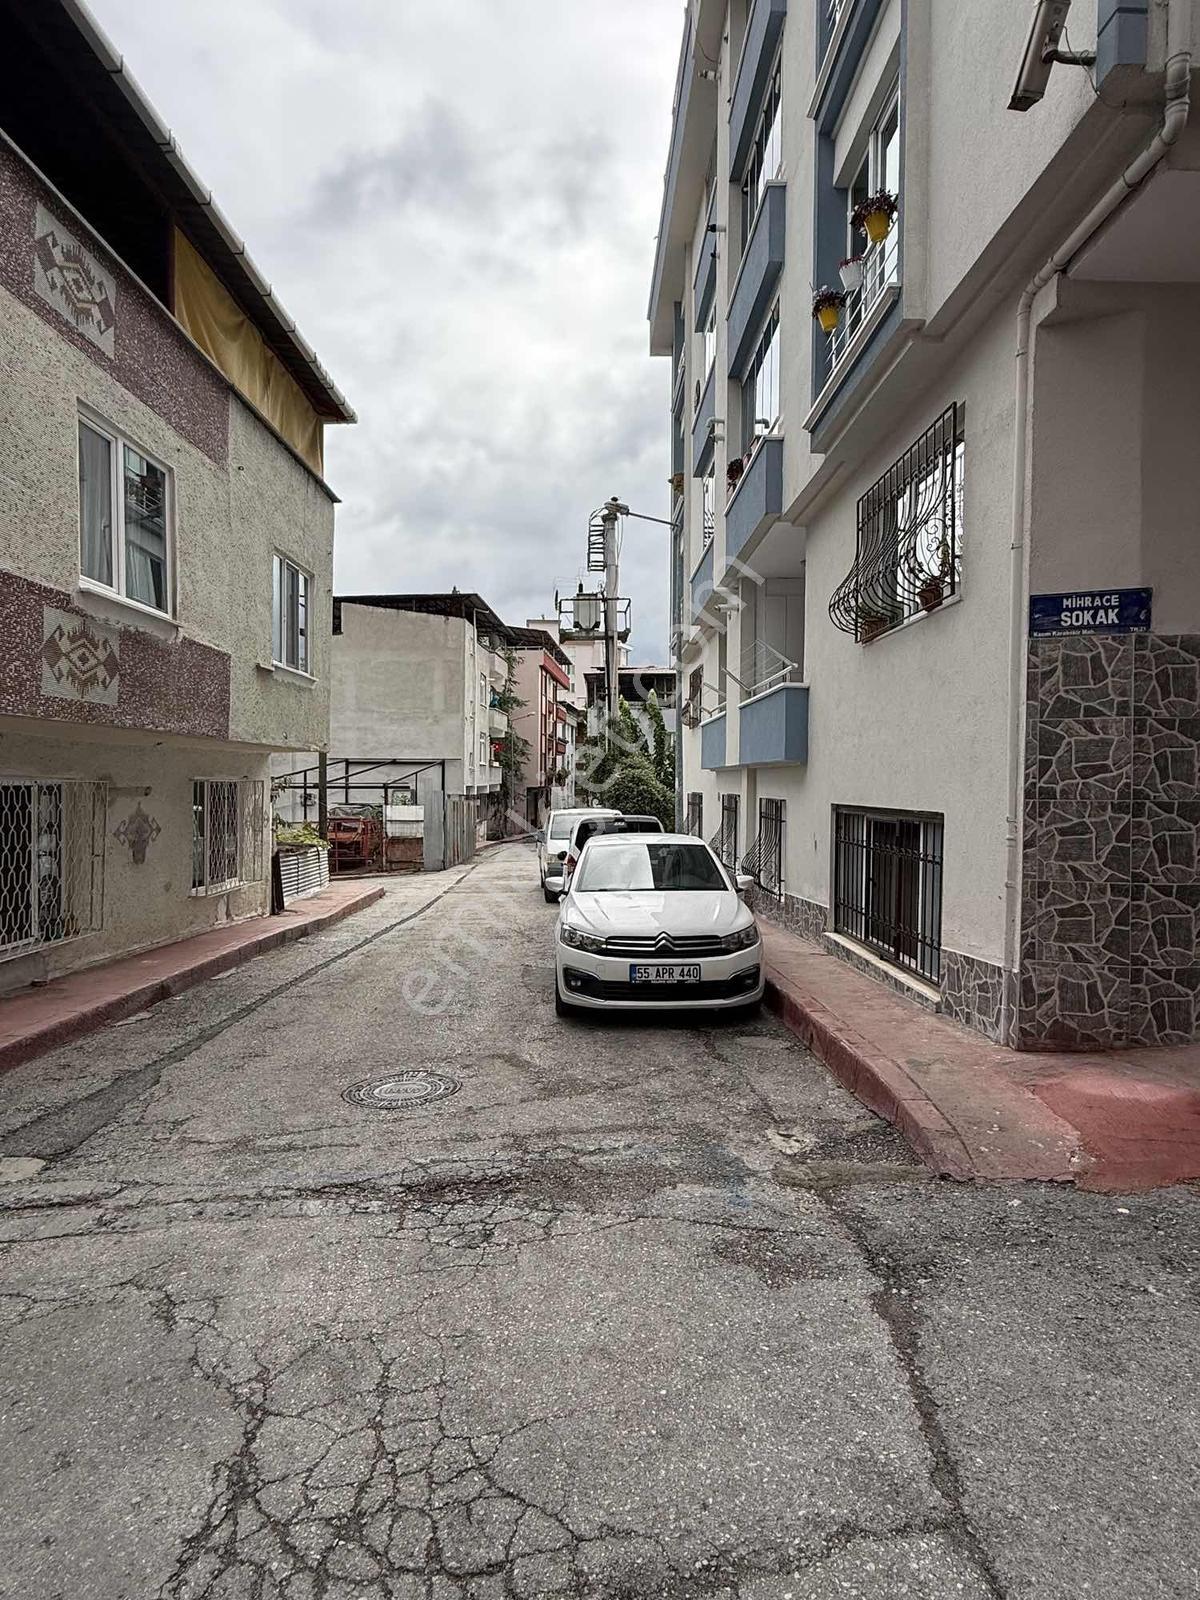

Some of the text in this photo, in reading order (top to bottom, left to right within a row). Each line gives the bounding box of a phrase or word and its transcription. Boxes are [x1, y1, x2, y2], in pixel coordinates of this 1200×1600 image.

[1063, 595, 1120, 609] MİHRACE
[1061, 608, 1119, 626] SOKAK
[637, 967, 699, 979] 55 APR 440
